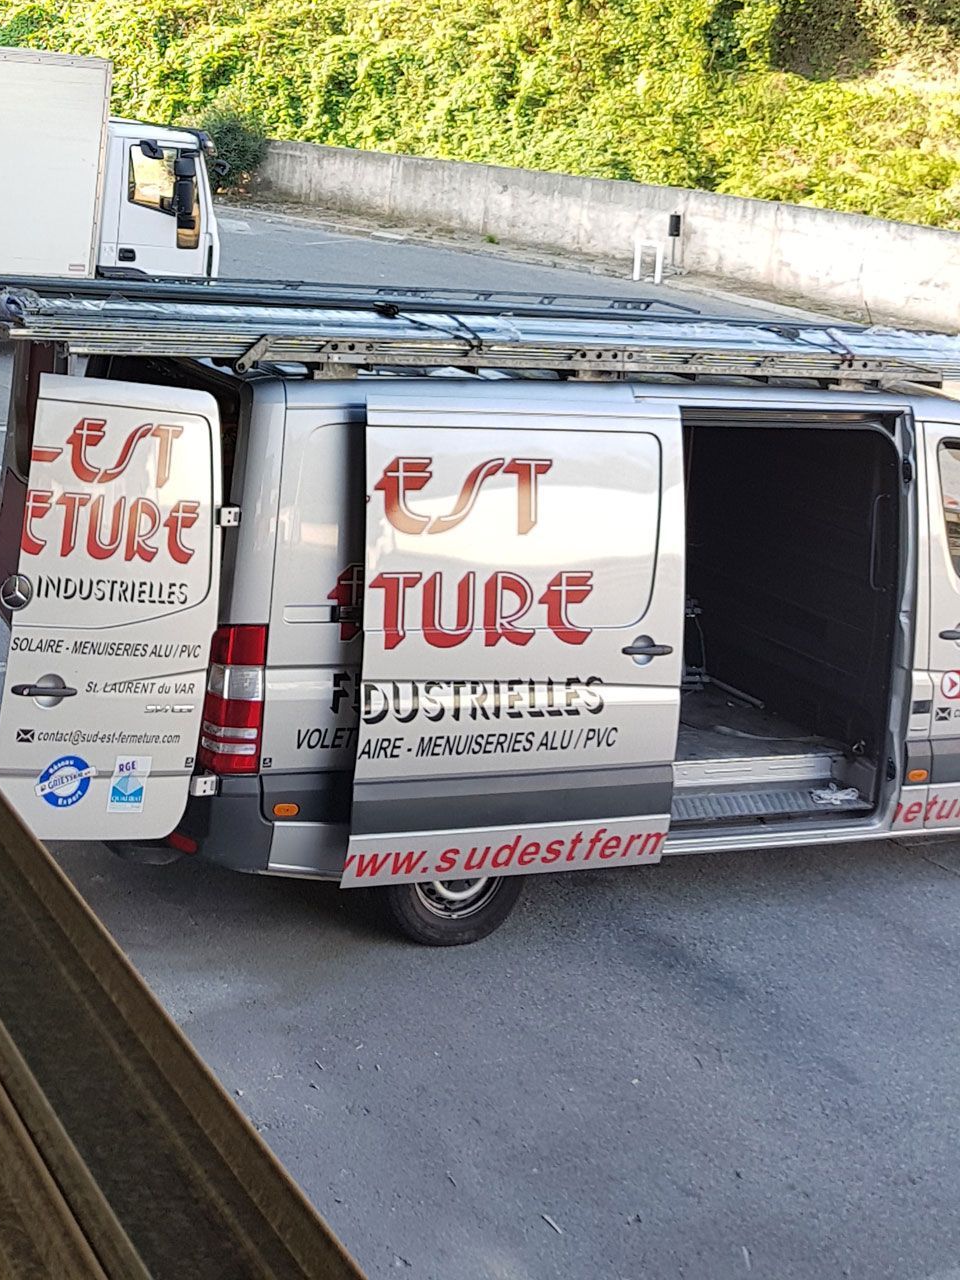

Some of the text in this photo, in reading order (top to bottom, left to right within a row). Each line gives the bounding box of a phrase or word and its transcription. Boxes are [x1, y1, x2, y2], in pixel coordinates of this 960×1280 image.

[21, 489, 200, 564] ETURE
[36, 575, 188, 605] INDUSTRIELLES
[11, 637, 64, 654] SOLAIRE
[71, 640, 149, 658] MENUISERIES
[149, 644, 173, 658] ALU
[179, 644, 202, 659] PVC
[85, 681, 195, 695] St. LAURENT du VAR
[361, 676, 605, 724] DUSTRIELLES
[37, 729, 180, 746] contact@sud-est-fermeture.com
[358, 737, 404, 760] AIRE
[416, 731, 535, 758] MENUISERIES
[536, 729, 571, 751] ALU
[584, 726, 618, 748] PVC
[118, 760, 136, 772] RGE
